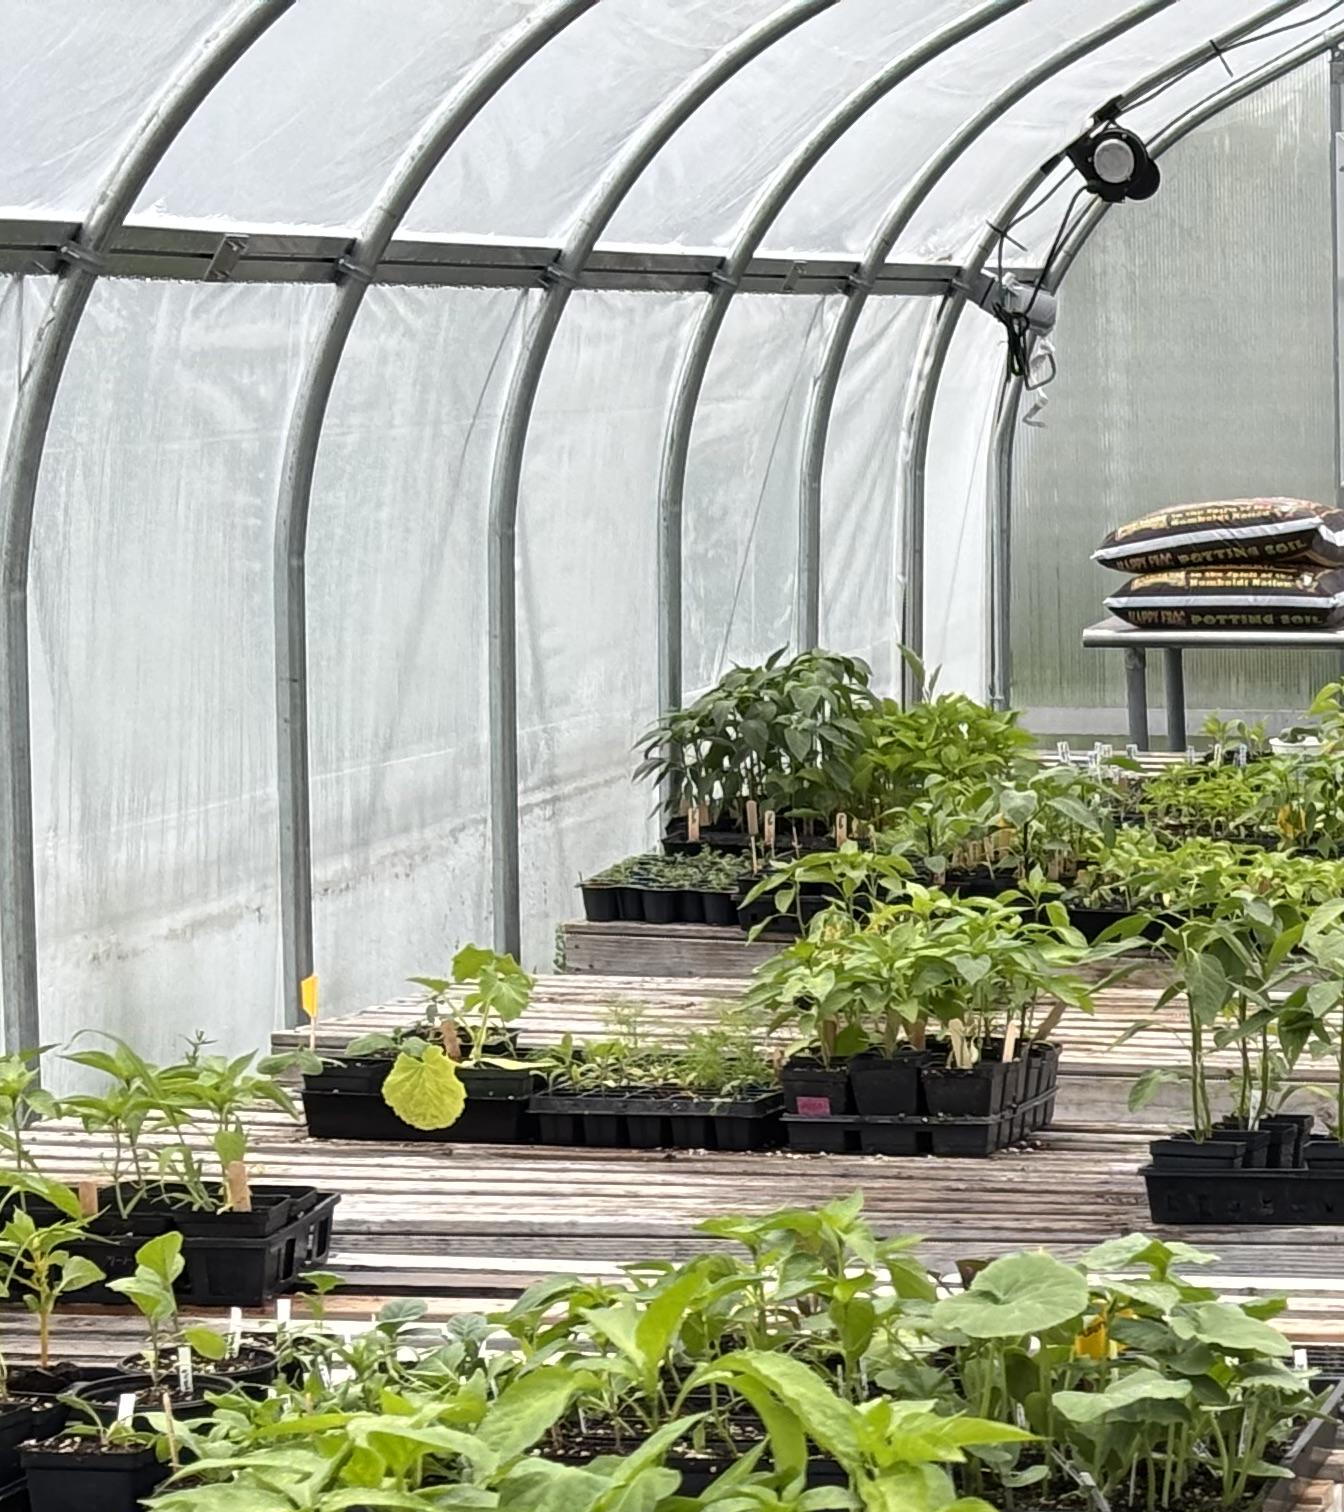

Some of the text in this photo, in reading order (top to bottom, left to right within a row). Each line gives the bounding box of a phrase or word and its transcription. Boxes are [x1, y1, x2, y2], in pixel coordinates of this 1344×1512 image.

[1178, 545, 1259, 564] POTTING
[1264, 538, 1308, 555] SOIL
[1189, 578, 1249, 588] Humboldt
[1128, 609, 1160, 625] HAPPY
[1191, 613, 1274, 626] POTTING
[1280, 613, 1323, 626] SOIL
